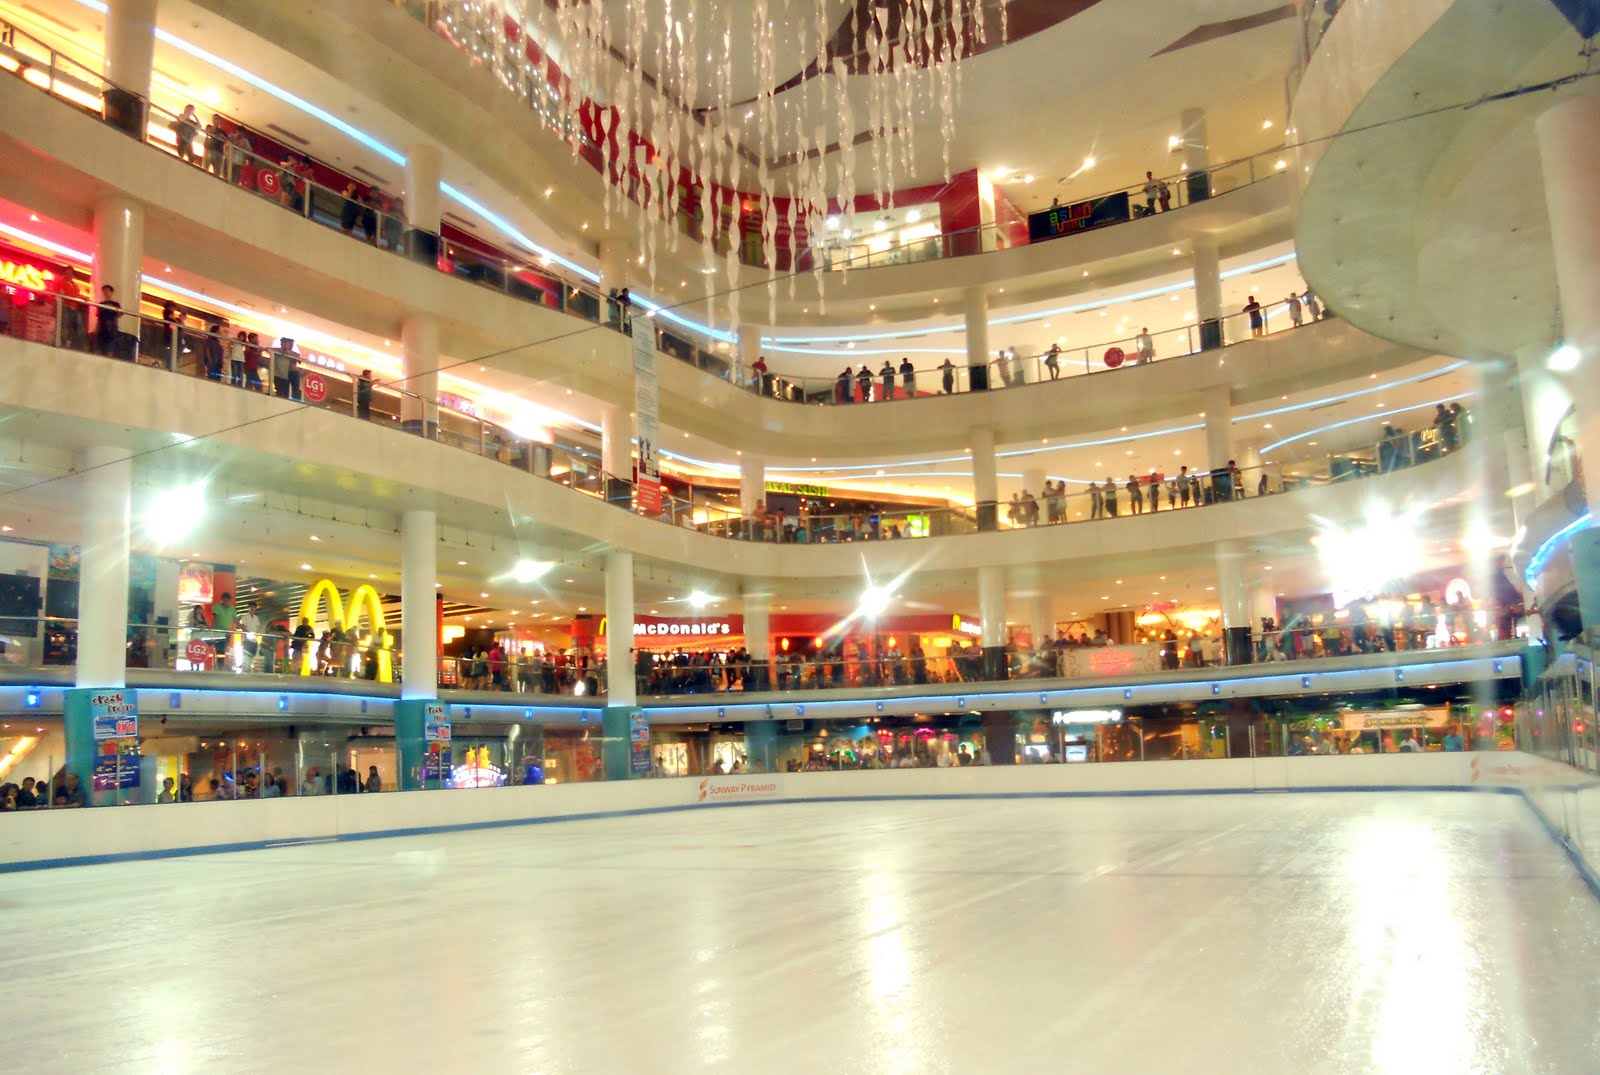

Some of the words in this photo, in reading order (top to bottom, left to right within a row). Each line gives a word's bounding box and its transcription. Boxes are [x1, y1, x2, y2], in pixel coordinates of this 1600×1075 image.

[1049, 204, 1092, 224] asin
[305, 378, 324, 393] LG1
[797, 484, 830, 497] SUSHI
[633, 622, 731, 635] McDonald's
[187, 643, 207, 655] LG2
[710, 785, 740, 794] SUNWAY
[741, 783, 777, 793] PYRAMID
